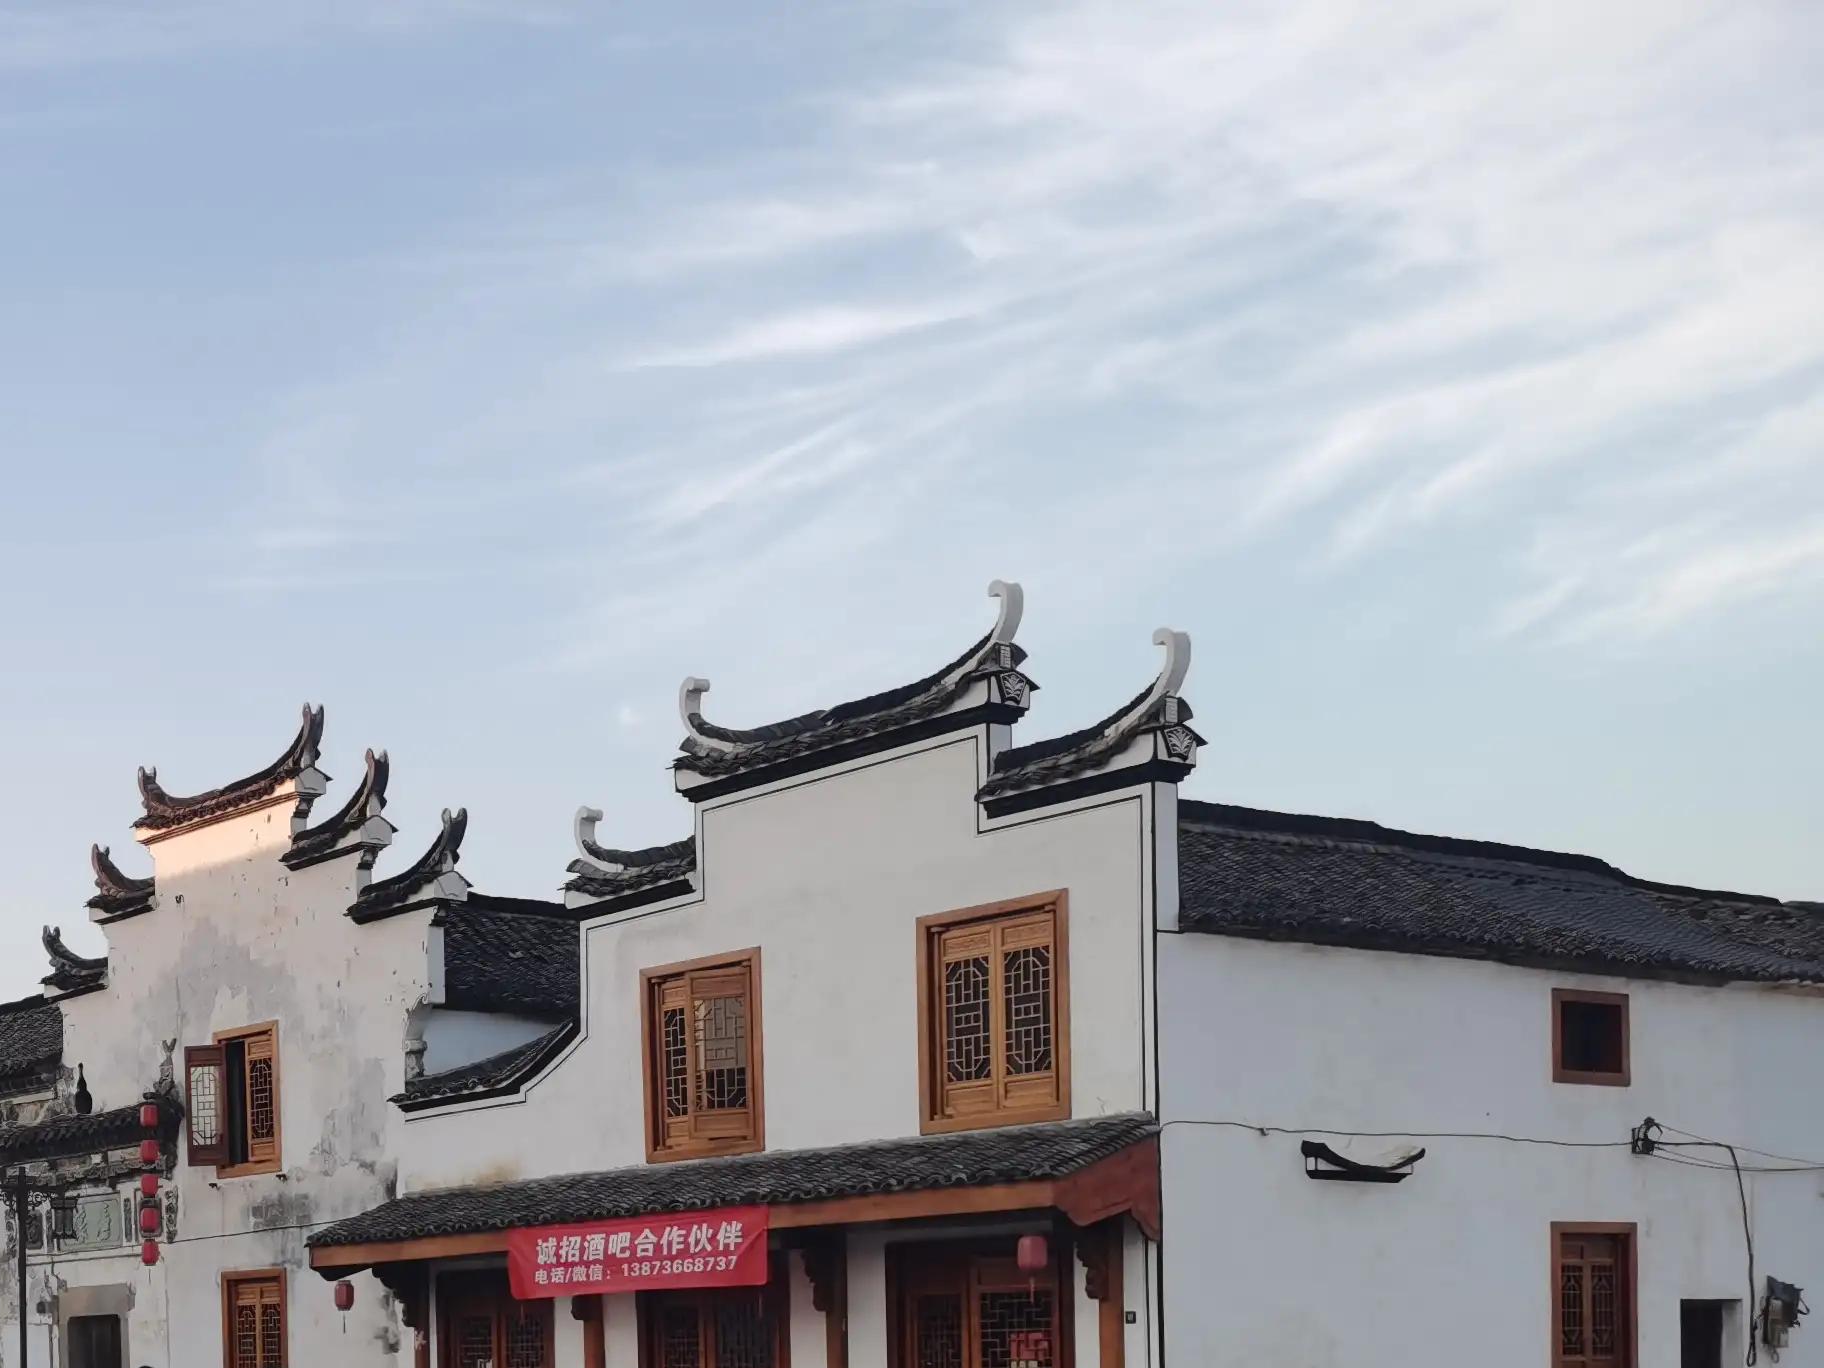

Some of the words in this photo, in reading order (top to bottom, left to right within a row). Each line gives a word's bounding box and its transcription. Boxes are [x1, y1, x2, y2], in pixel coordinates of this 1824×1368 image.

[537, 1220, 744, 1264] 诚招酒吧合作伙伴
